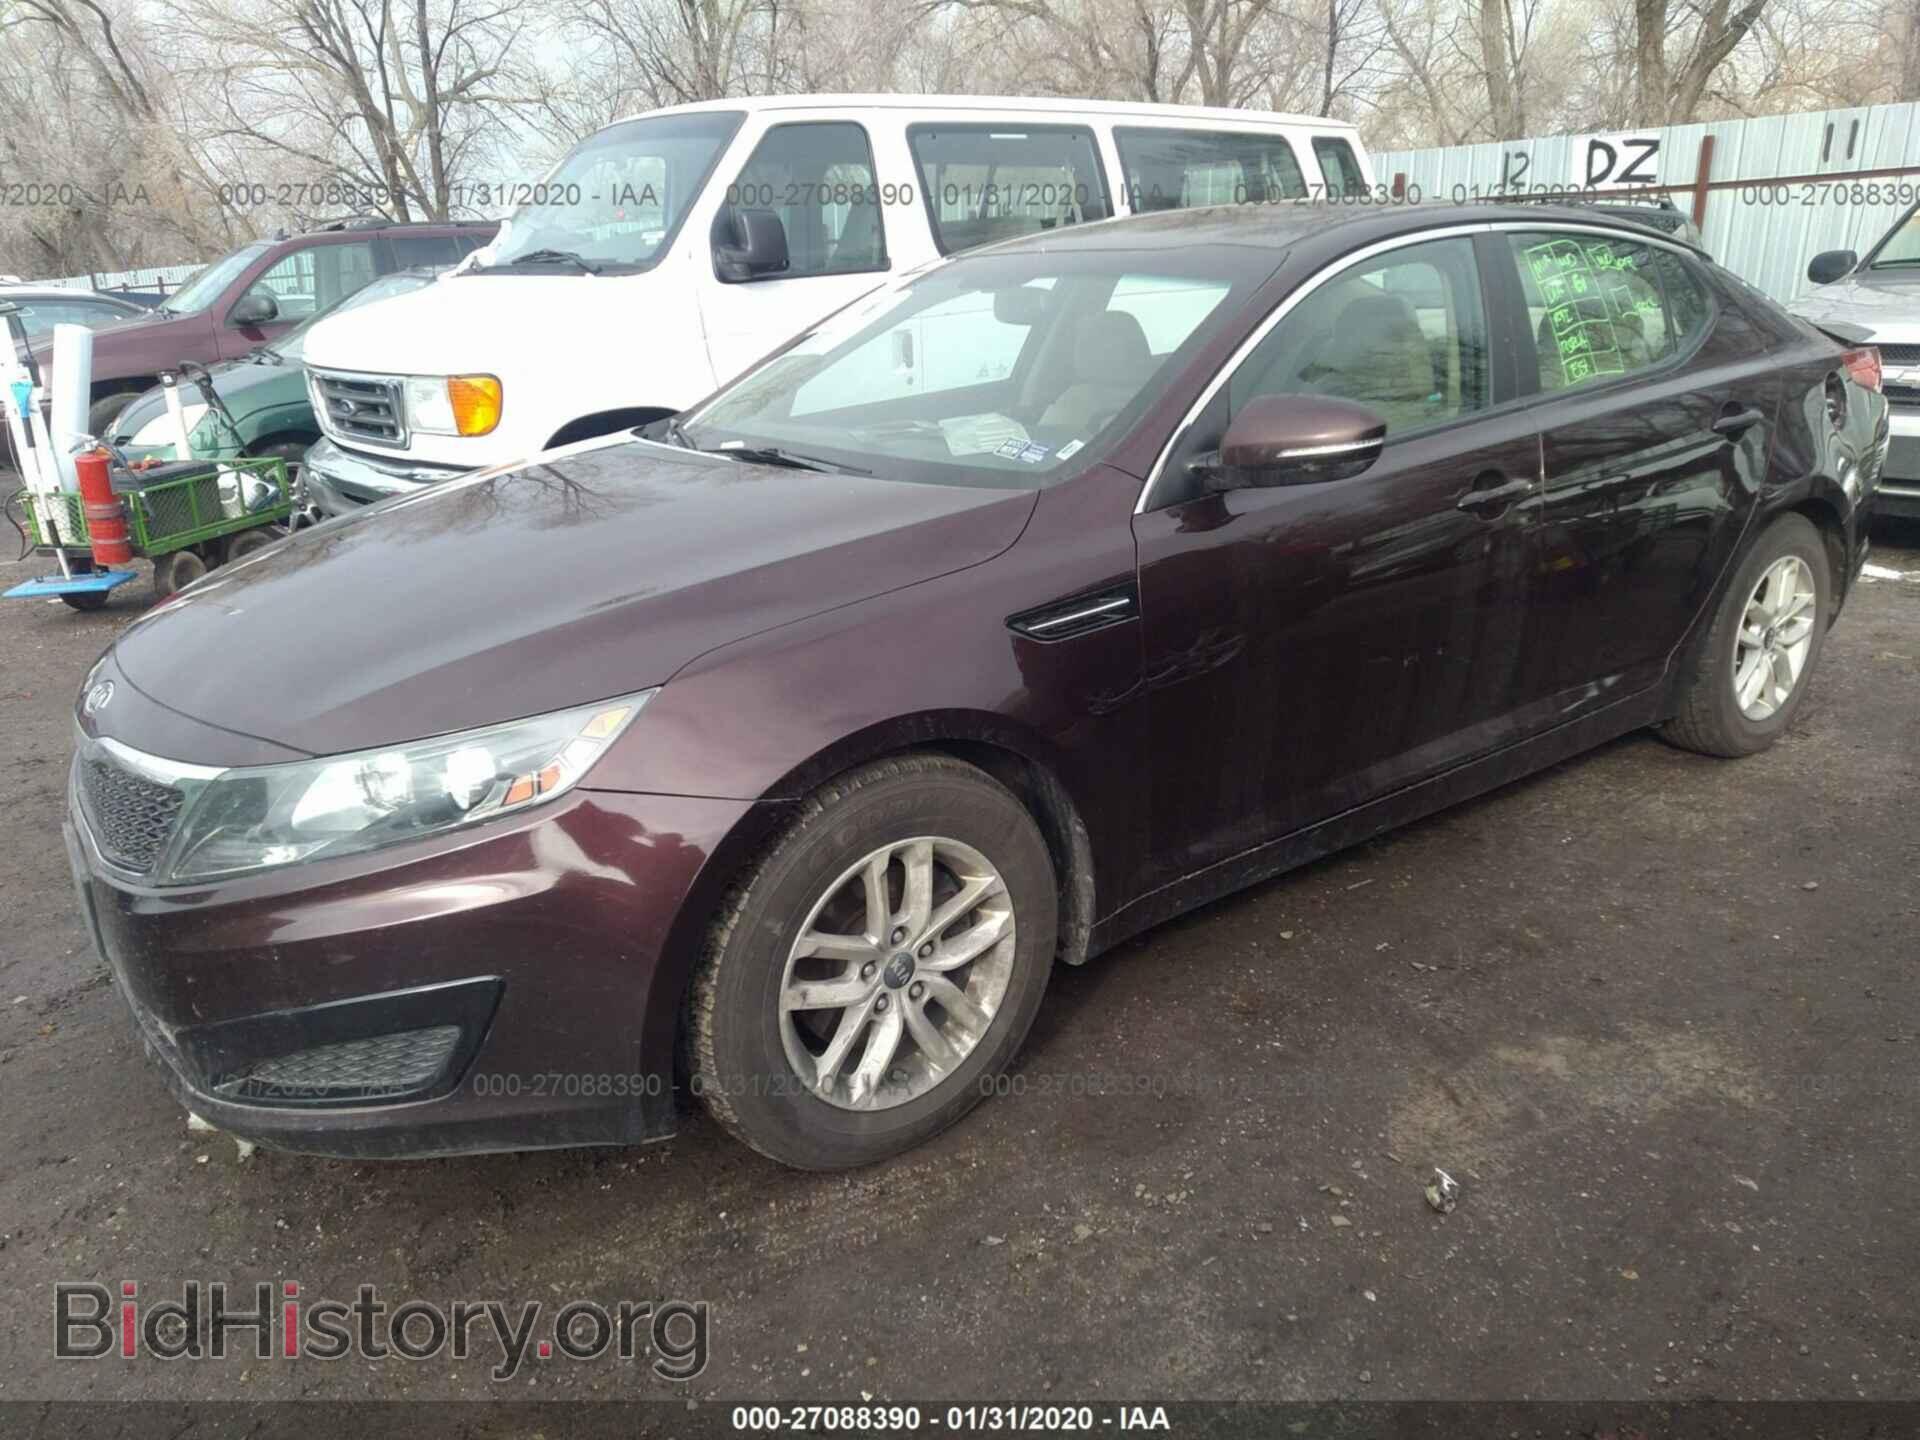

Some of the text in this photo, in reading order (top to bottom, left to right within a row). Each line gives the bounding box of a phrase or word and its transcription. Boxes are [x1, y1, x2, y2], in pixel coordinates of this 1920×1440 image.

[1586, 138, 1661, 186] DZ
[1823, 119, 1859, 163] 11
[1502, 152, 1530, 189] 12
